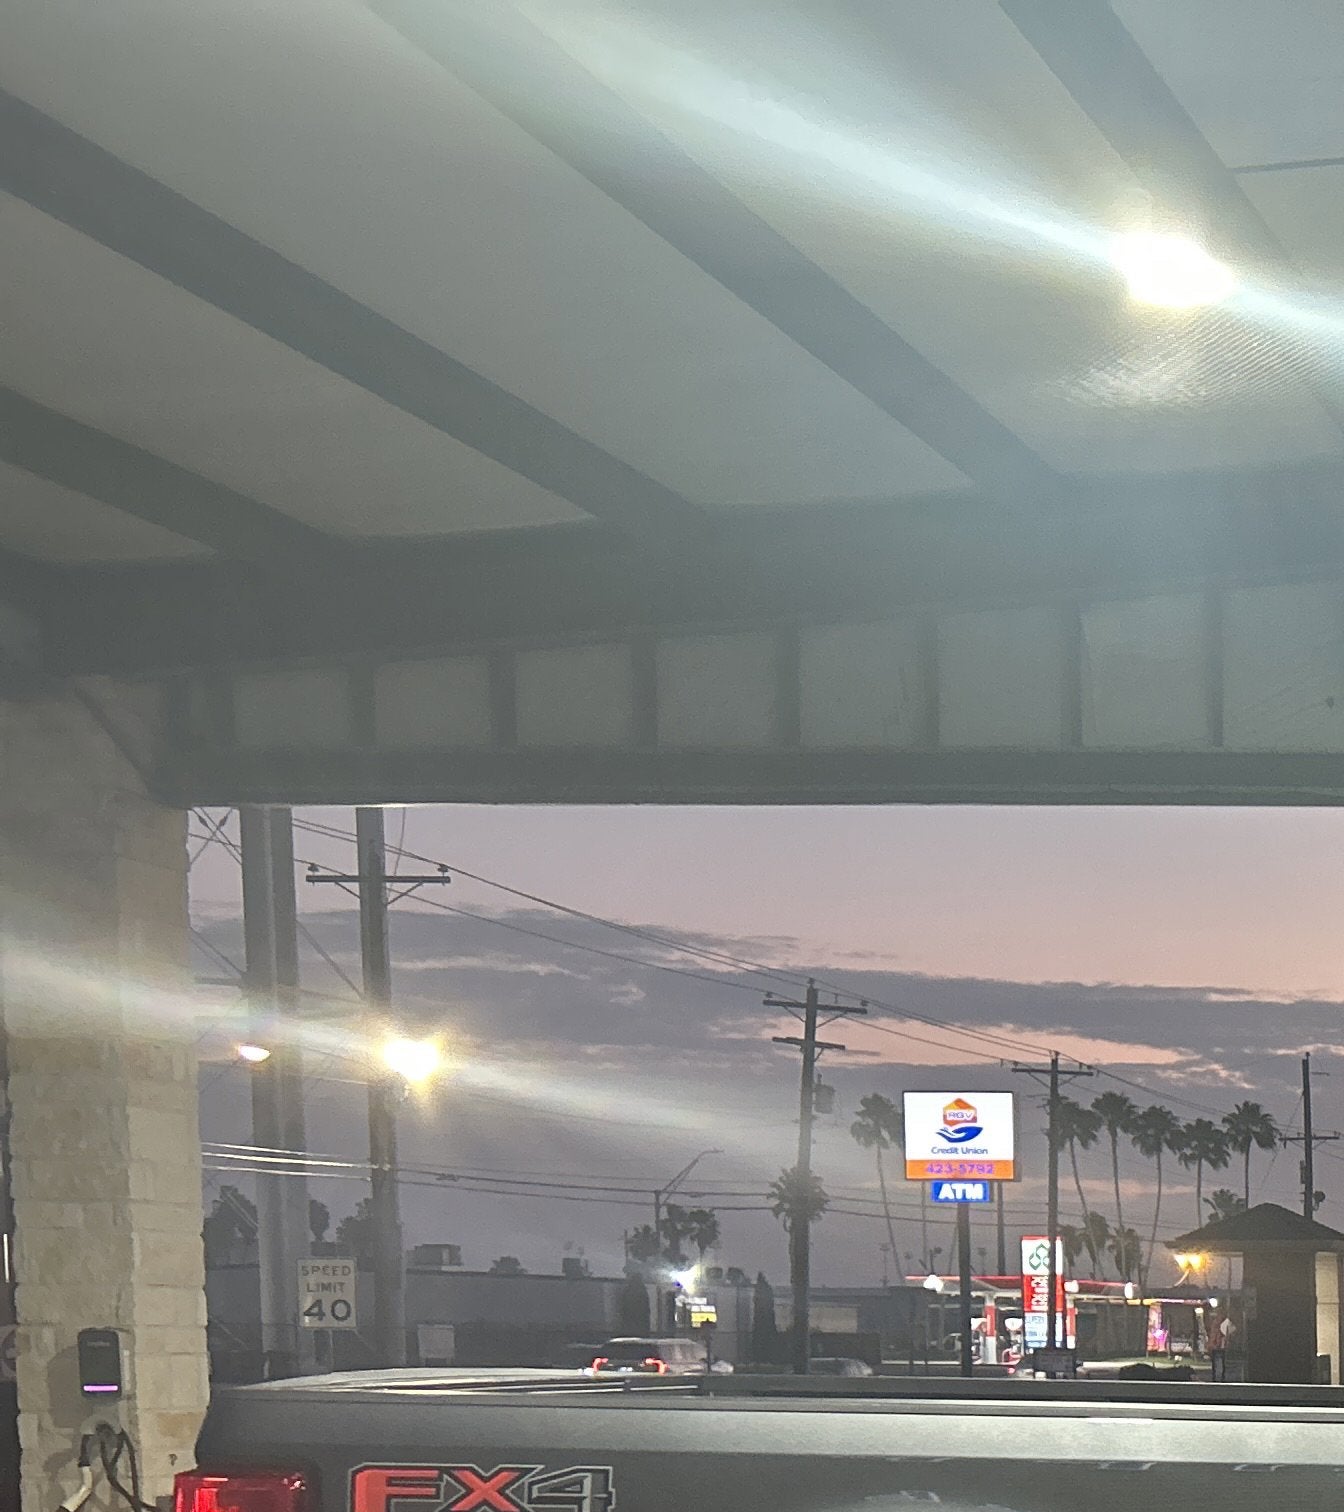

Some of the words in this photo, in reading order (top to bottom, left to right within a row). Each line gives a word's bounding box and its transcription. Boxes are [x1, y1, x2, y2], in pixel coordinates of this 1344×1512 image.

[931, 1146, 959, 1155] Credit
[961, 1146, 989, 1155] Union
[937, 1183, 984, 1200] ATM
[301, 1265, 351, 1277] SPEED
[306, 1281, 346, 1294] LIMIT
[303, 1299, 351, 1322] 40
